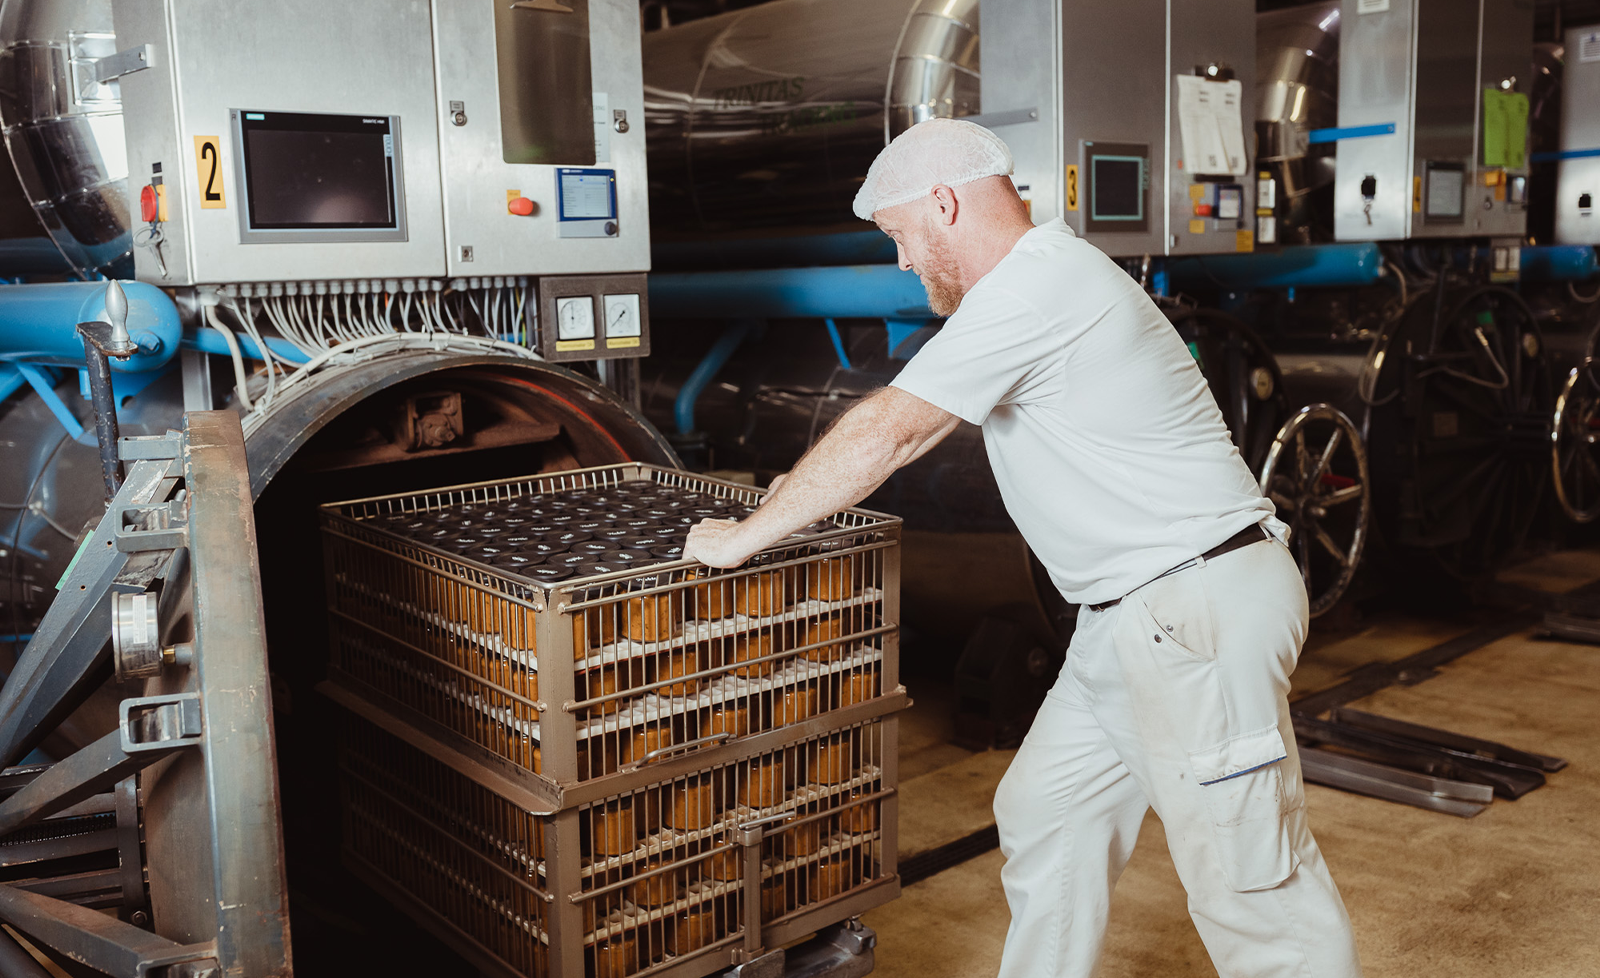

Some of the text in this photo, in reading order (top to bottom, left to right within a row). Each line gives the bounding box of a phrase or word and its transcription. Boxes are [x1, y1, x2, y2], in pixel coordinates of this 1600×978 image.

[713, 76, 806, 110] TRINITAS
[201, 142, 221, 201] 2
[1069, 169, 1077, 206] 3
